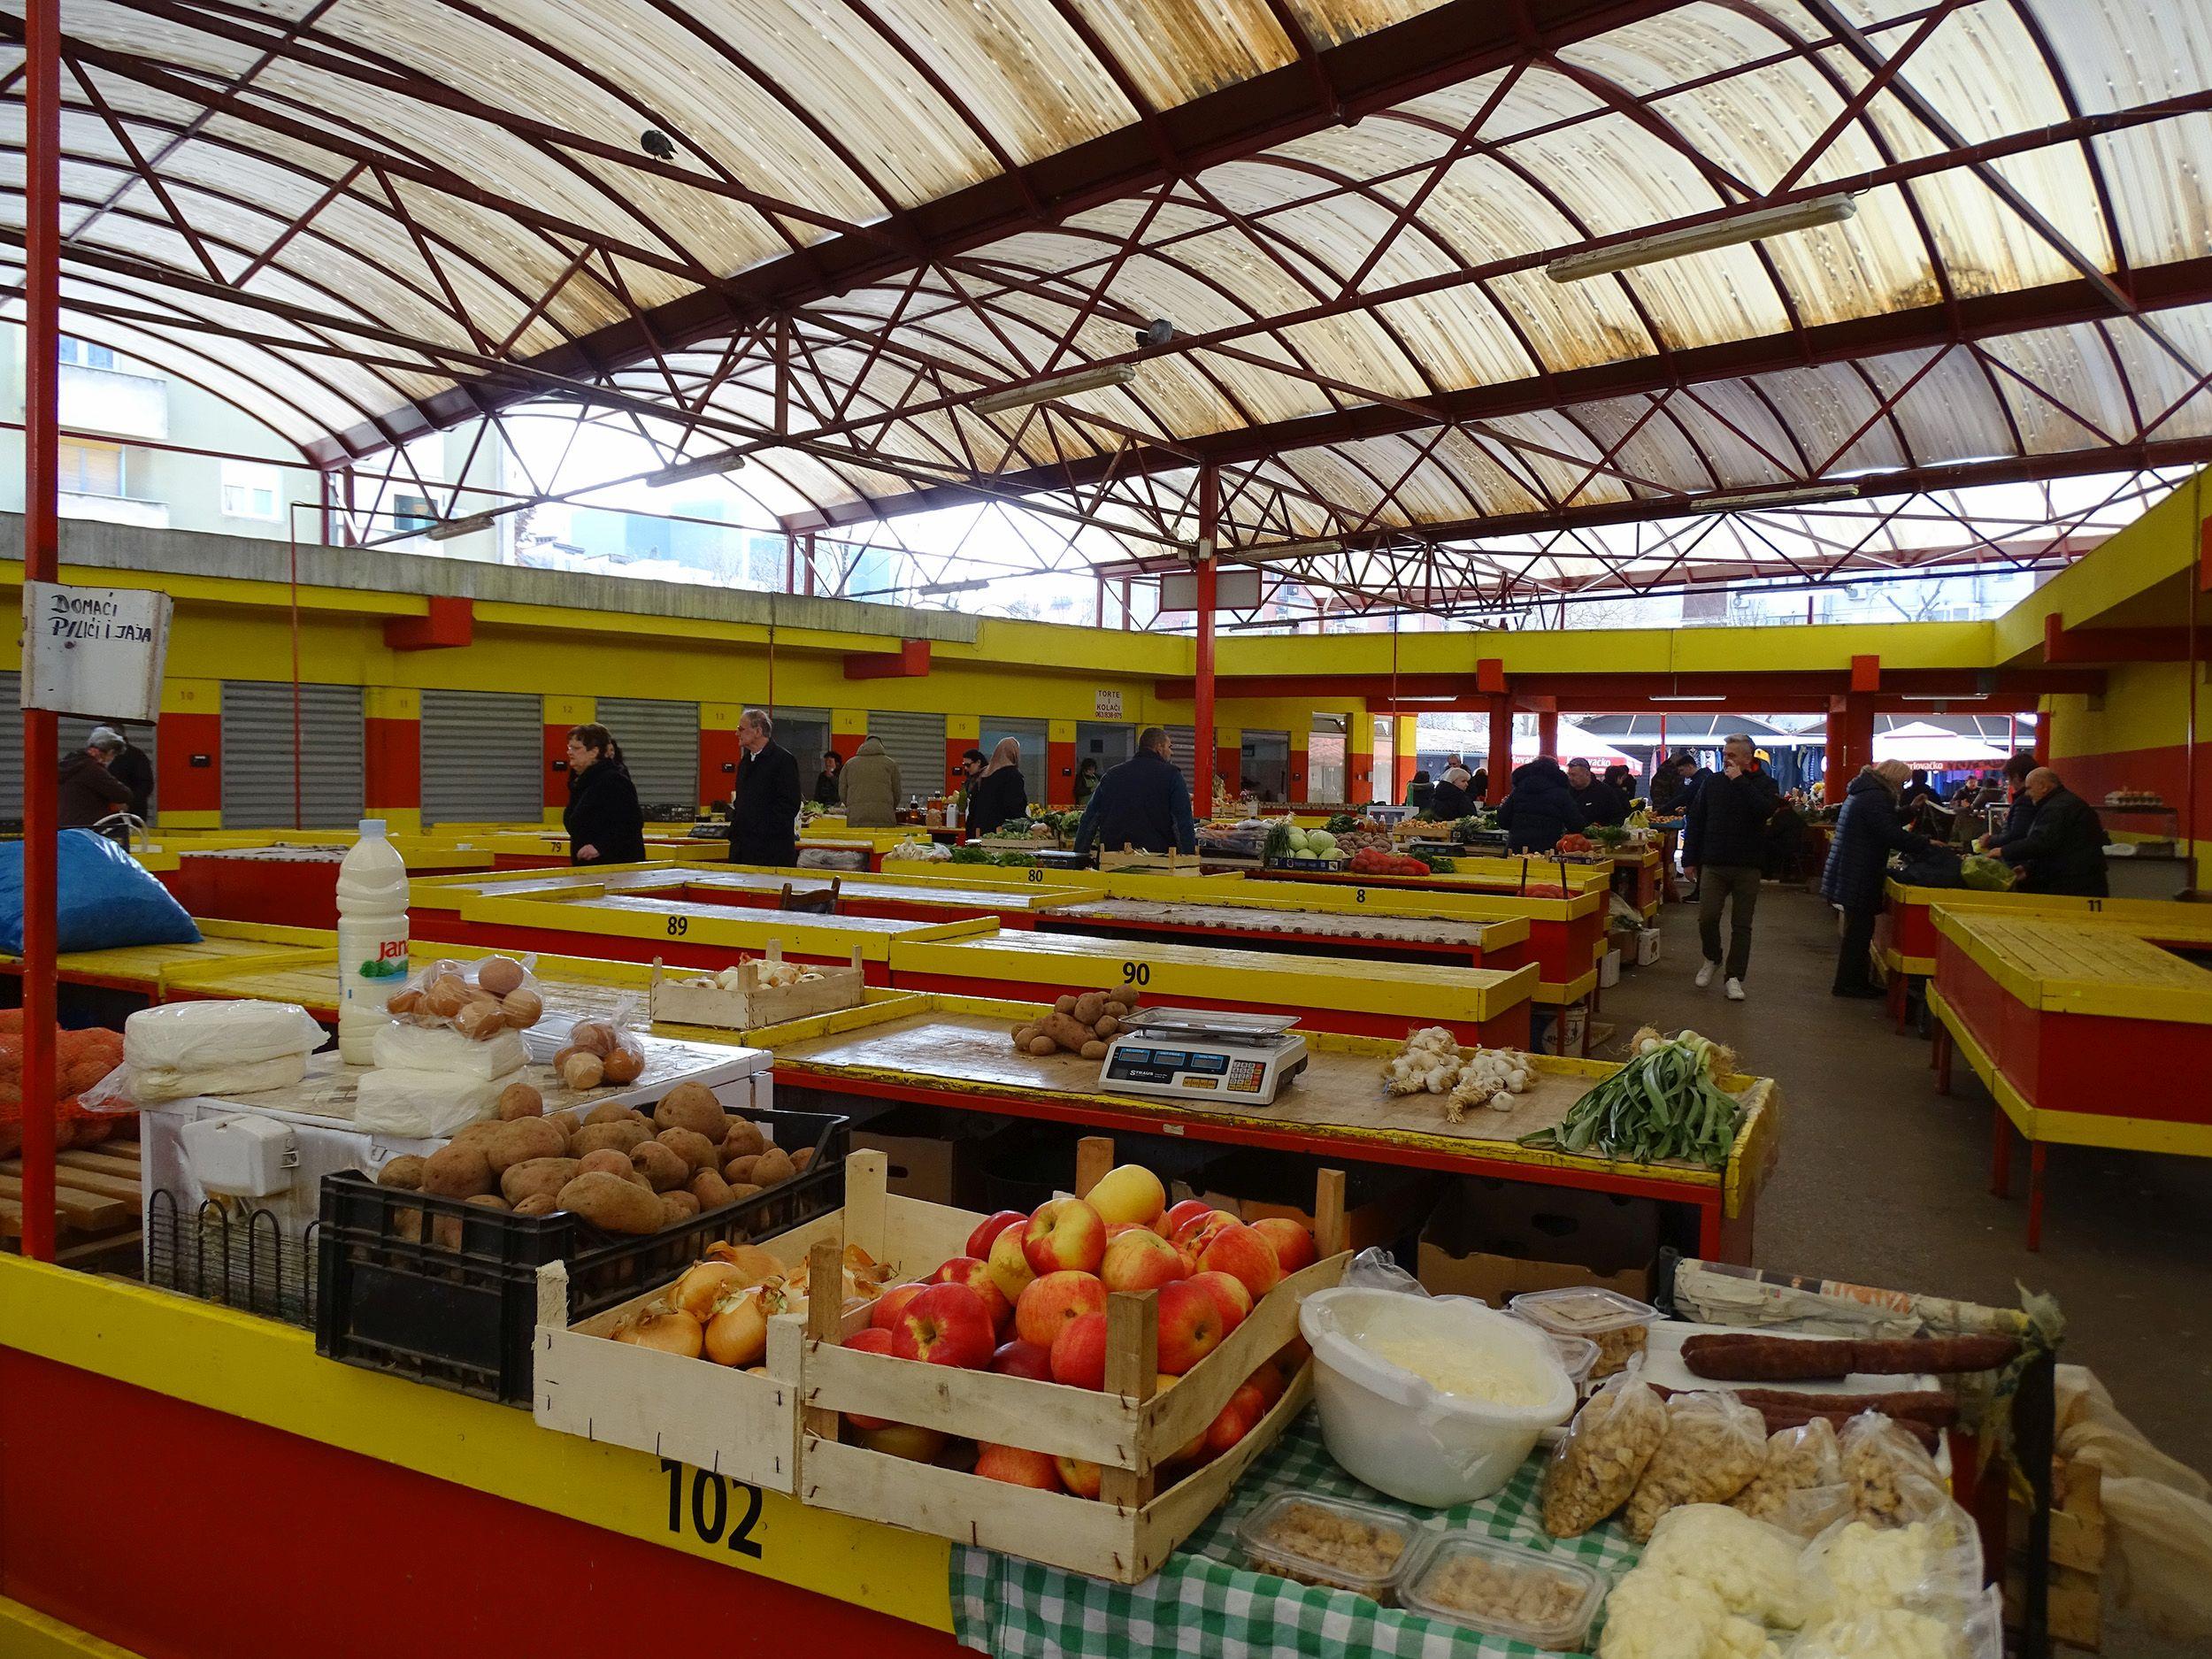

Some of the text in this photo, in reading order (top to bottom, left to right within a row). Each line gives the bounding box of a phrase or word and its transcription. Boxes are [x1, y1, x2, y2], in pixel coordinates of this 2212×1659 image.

[551, 841, 562, 853] 79
[1028, 869, 1043, 882] 80
[1356, 888, 1366, 903] 8
[2087, 899, 2102, 913] 11
[667, 916, 688, 936] 89
[1123, 961, 1150, 987] 90
[660, 1458, 763, 1560] 102
